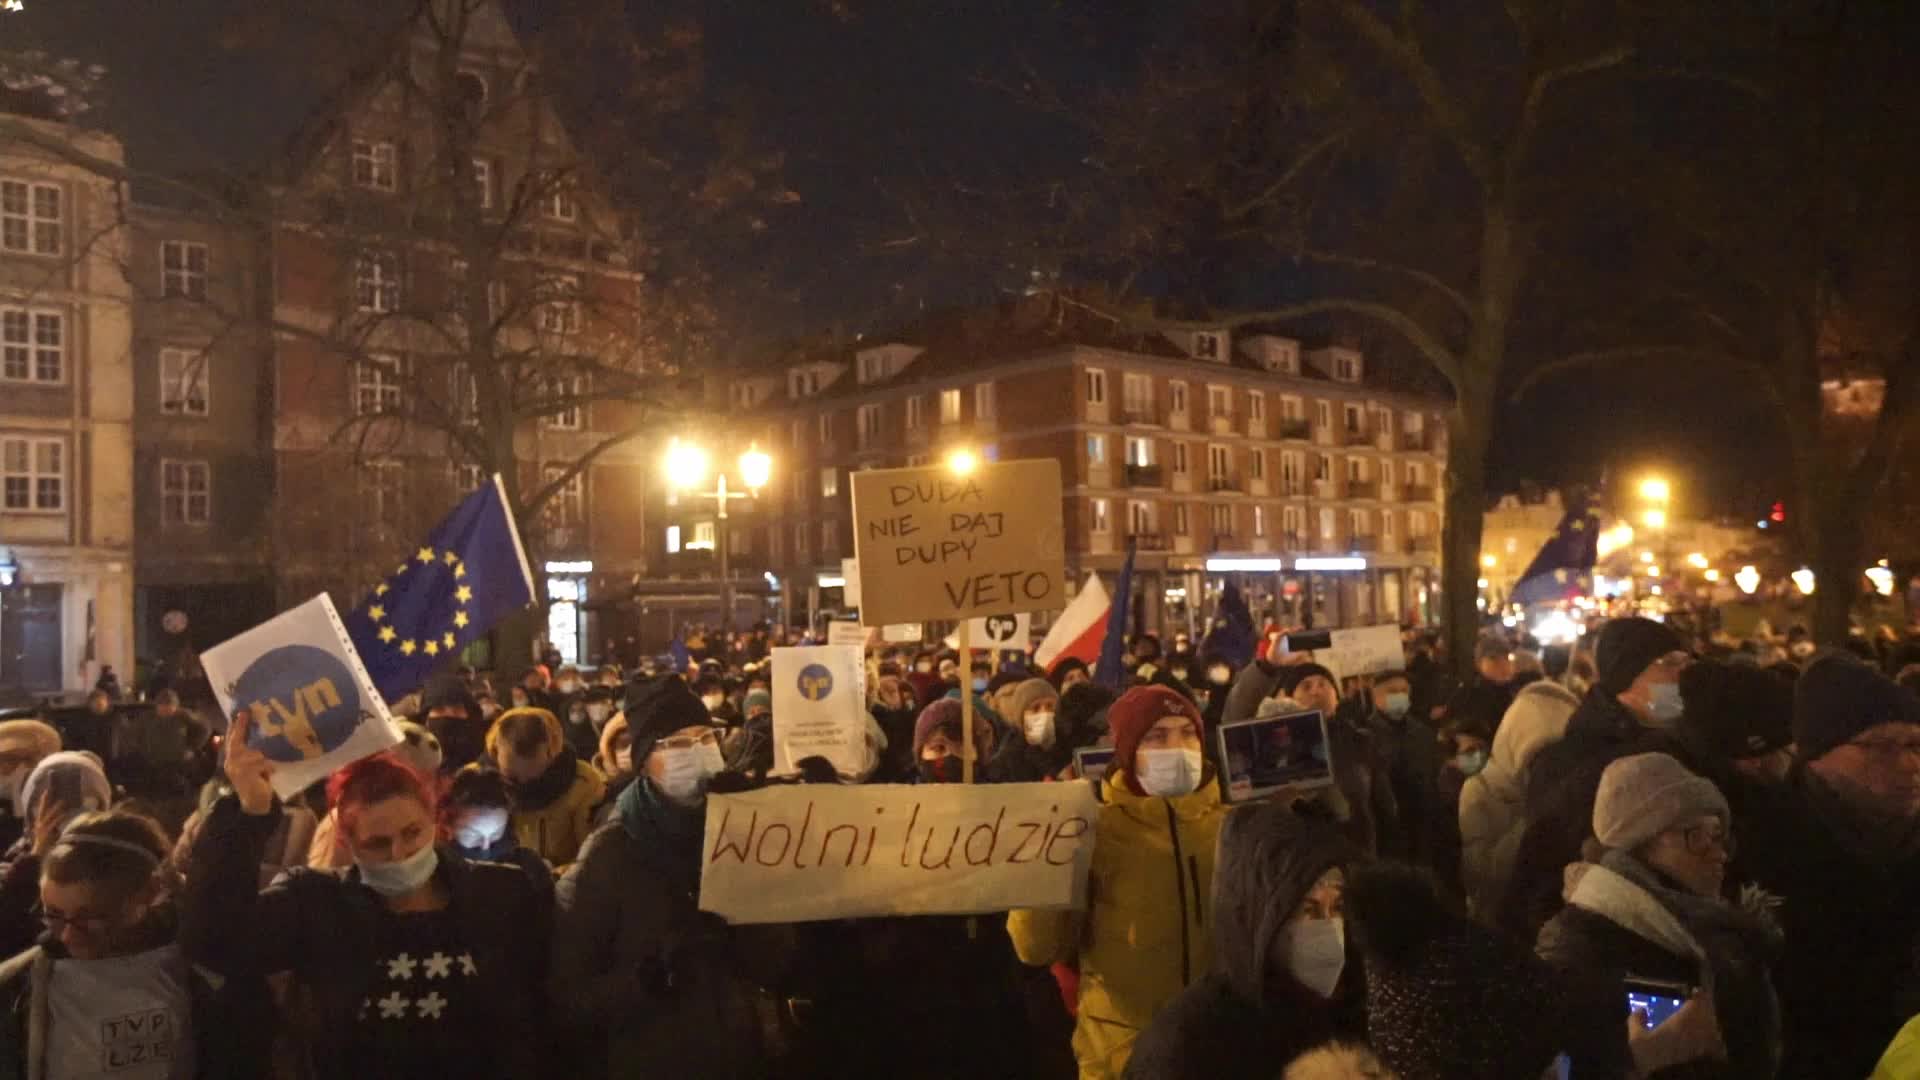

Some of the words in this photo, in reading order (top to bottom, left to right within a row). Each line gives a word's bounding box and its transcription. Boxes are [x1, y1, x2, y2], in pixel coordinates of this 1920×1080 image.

[889, 479, 983, 507] DUDA
[869, 514, 921, 540] NIE
[951, 512, 1004, 538] DAJ
[896, 539, 977, 566] DUPY
[944, 570, 1050, 610] VETO
[711, 801, 884, 869] Wolni
[900, 803, 1089, 870] ludzie
[107, 1014, 165, 1039] TVP
